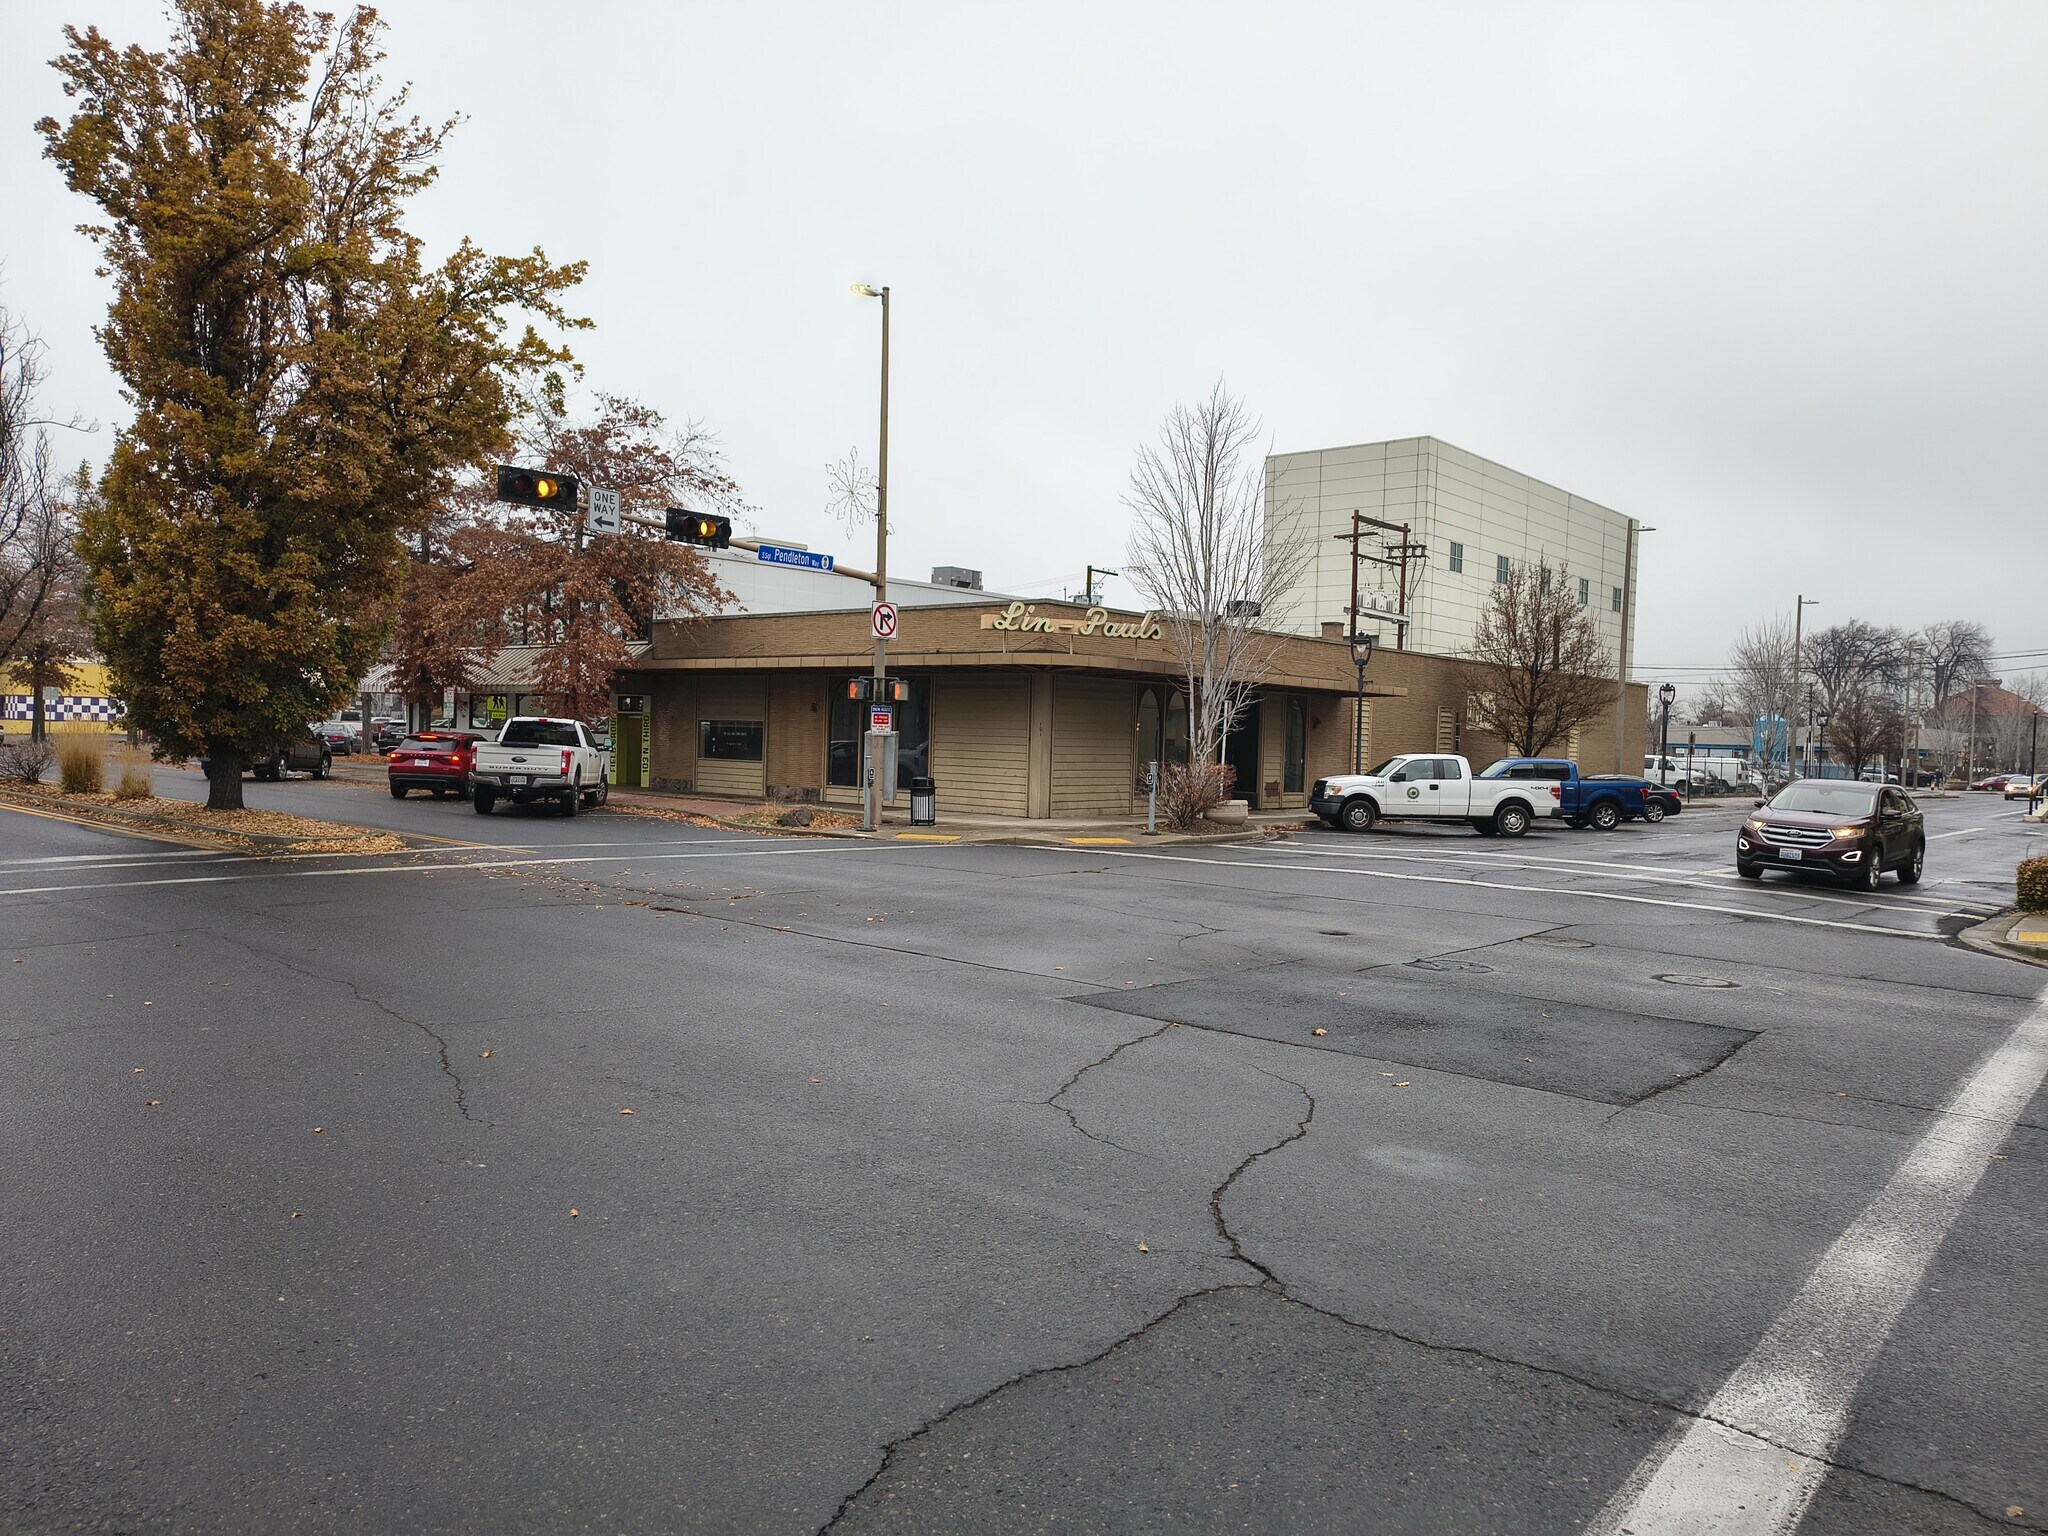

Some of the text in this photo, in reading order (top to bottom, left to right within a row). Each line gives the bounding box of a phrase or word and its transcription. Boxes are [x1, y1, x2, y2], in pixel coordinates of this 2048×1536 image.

[594, 491, 616, 505] ONE
[593, 502, 616, 516] WAY
[774, 548, 810, 566] Pendleton
[642, 715, 650, 744] THIRD
[642, 757, 650, 774] 103
